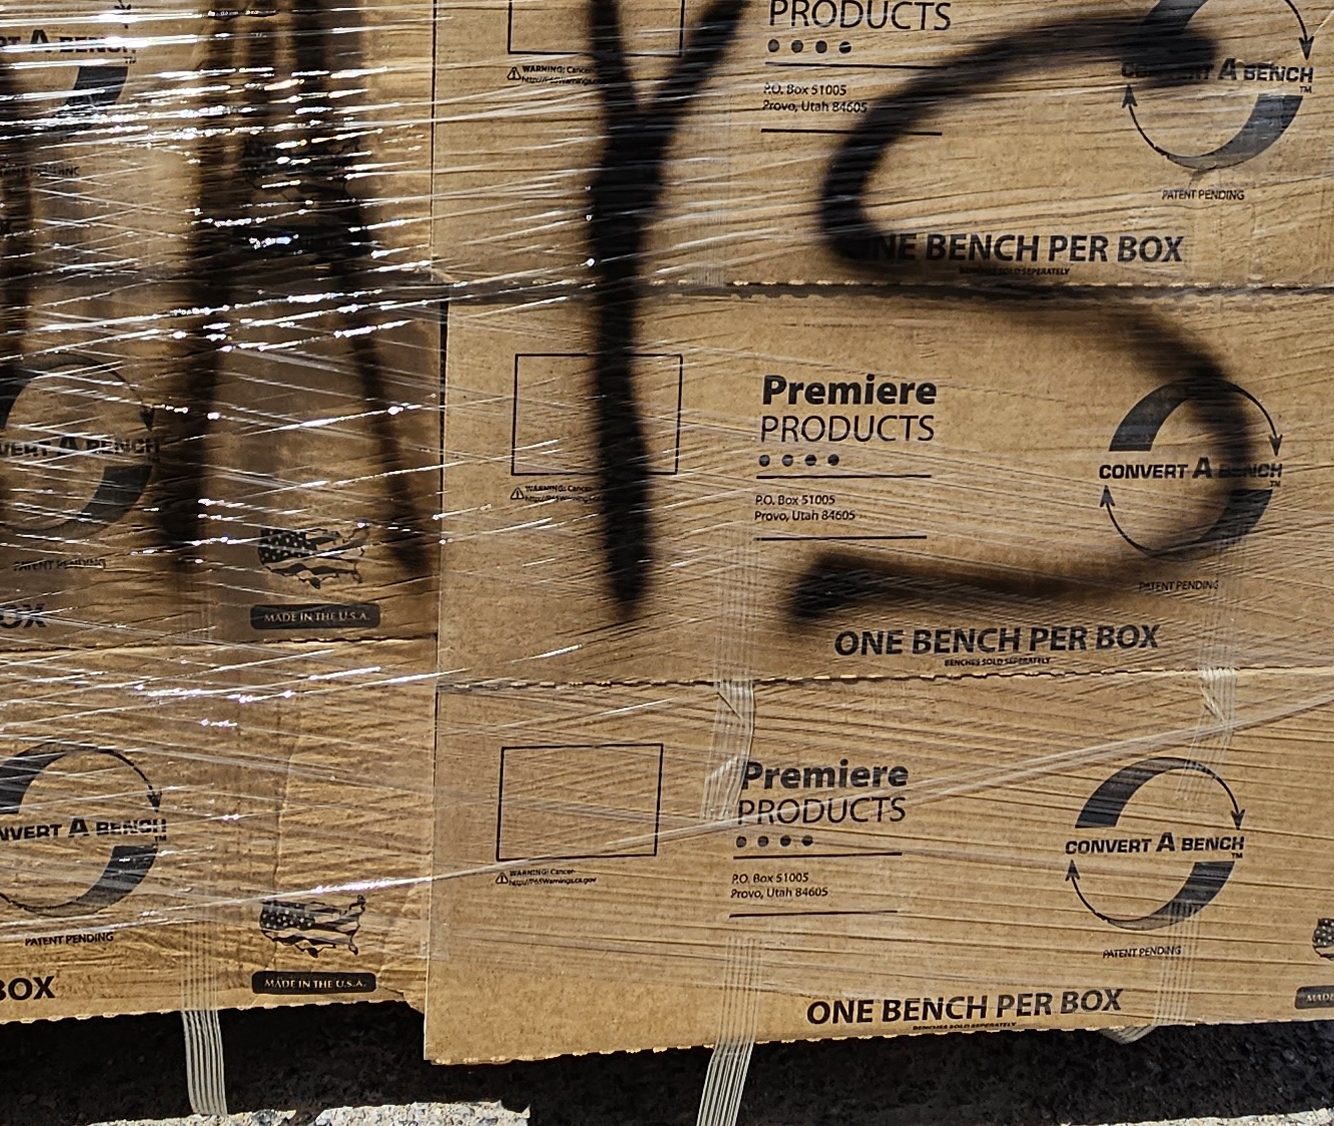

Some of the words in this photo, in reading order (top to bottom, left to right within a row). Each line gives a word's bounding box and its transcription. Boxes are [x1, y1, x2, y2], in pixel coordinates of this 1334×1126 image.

[1218, 58, 1240, 81] A
[1243, 64, 1313, 83] BENCH
[1162, 189, 1195, 200] PATENT
[1197, 190, 1244, 202] PENDING
[925, 234, 1039, 262] BENCH
[1049, 234, 1107, 262] PER
[1117, 234, 1183, 263] BOX
[762, 373, 937, 405] Premiere
[761, 414, 935, 443] PRODUCTS
[1099, 463, 1187, 480] CONVERT
[1192, 457, 1212, 479] A
[778, 494, 799, 505] Box
[802, 494, 835, 505] 51005
[754, 510, 788, 522] Provo,
[792, 510, 818, 521] Utah
[821, 509, 855, 521] 84605
[835, 630, 902, 656] ONE
[912, 627, 1020, 654] BENCH
[1029, 626, 1087, 652] PER
[1096, 624, 1159, 650] BOX
[743, 759, 908, 789] Premiere
[738, 797, 906, 824] PRODUCTS
[68, 818, 90, 838] A
[96, 818, 167, 836] BENCH
[1066, 837, 1151, 855] CONVERT
[1156, 833, 1175, 852] A
[1182, 836, 1244, 852] BENCH
[753, 874, 773, 884] Box
[776, 872, 809, 884] 51005
[731, 889, 763, 900] Provo,
[767, 887, 792, 899] Utah
[795, 887, 828, 899] 84605
[25, 936, 62, 946] PATENT
[65, 932, 113, 944] PENDING
[266, 978, 297, 989] MADE
[298, 978, 310, 989] IN
[313, 978, 333, 989] THE
[336, 977, 366, 988] U.S.A.
[808, 1000, 873, 1024] ONE
[882, 997, 986, 1023] BENCH
[997, 993, 1052, 1018] PER
[1061, 988, 1123, 1014] BOX
